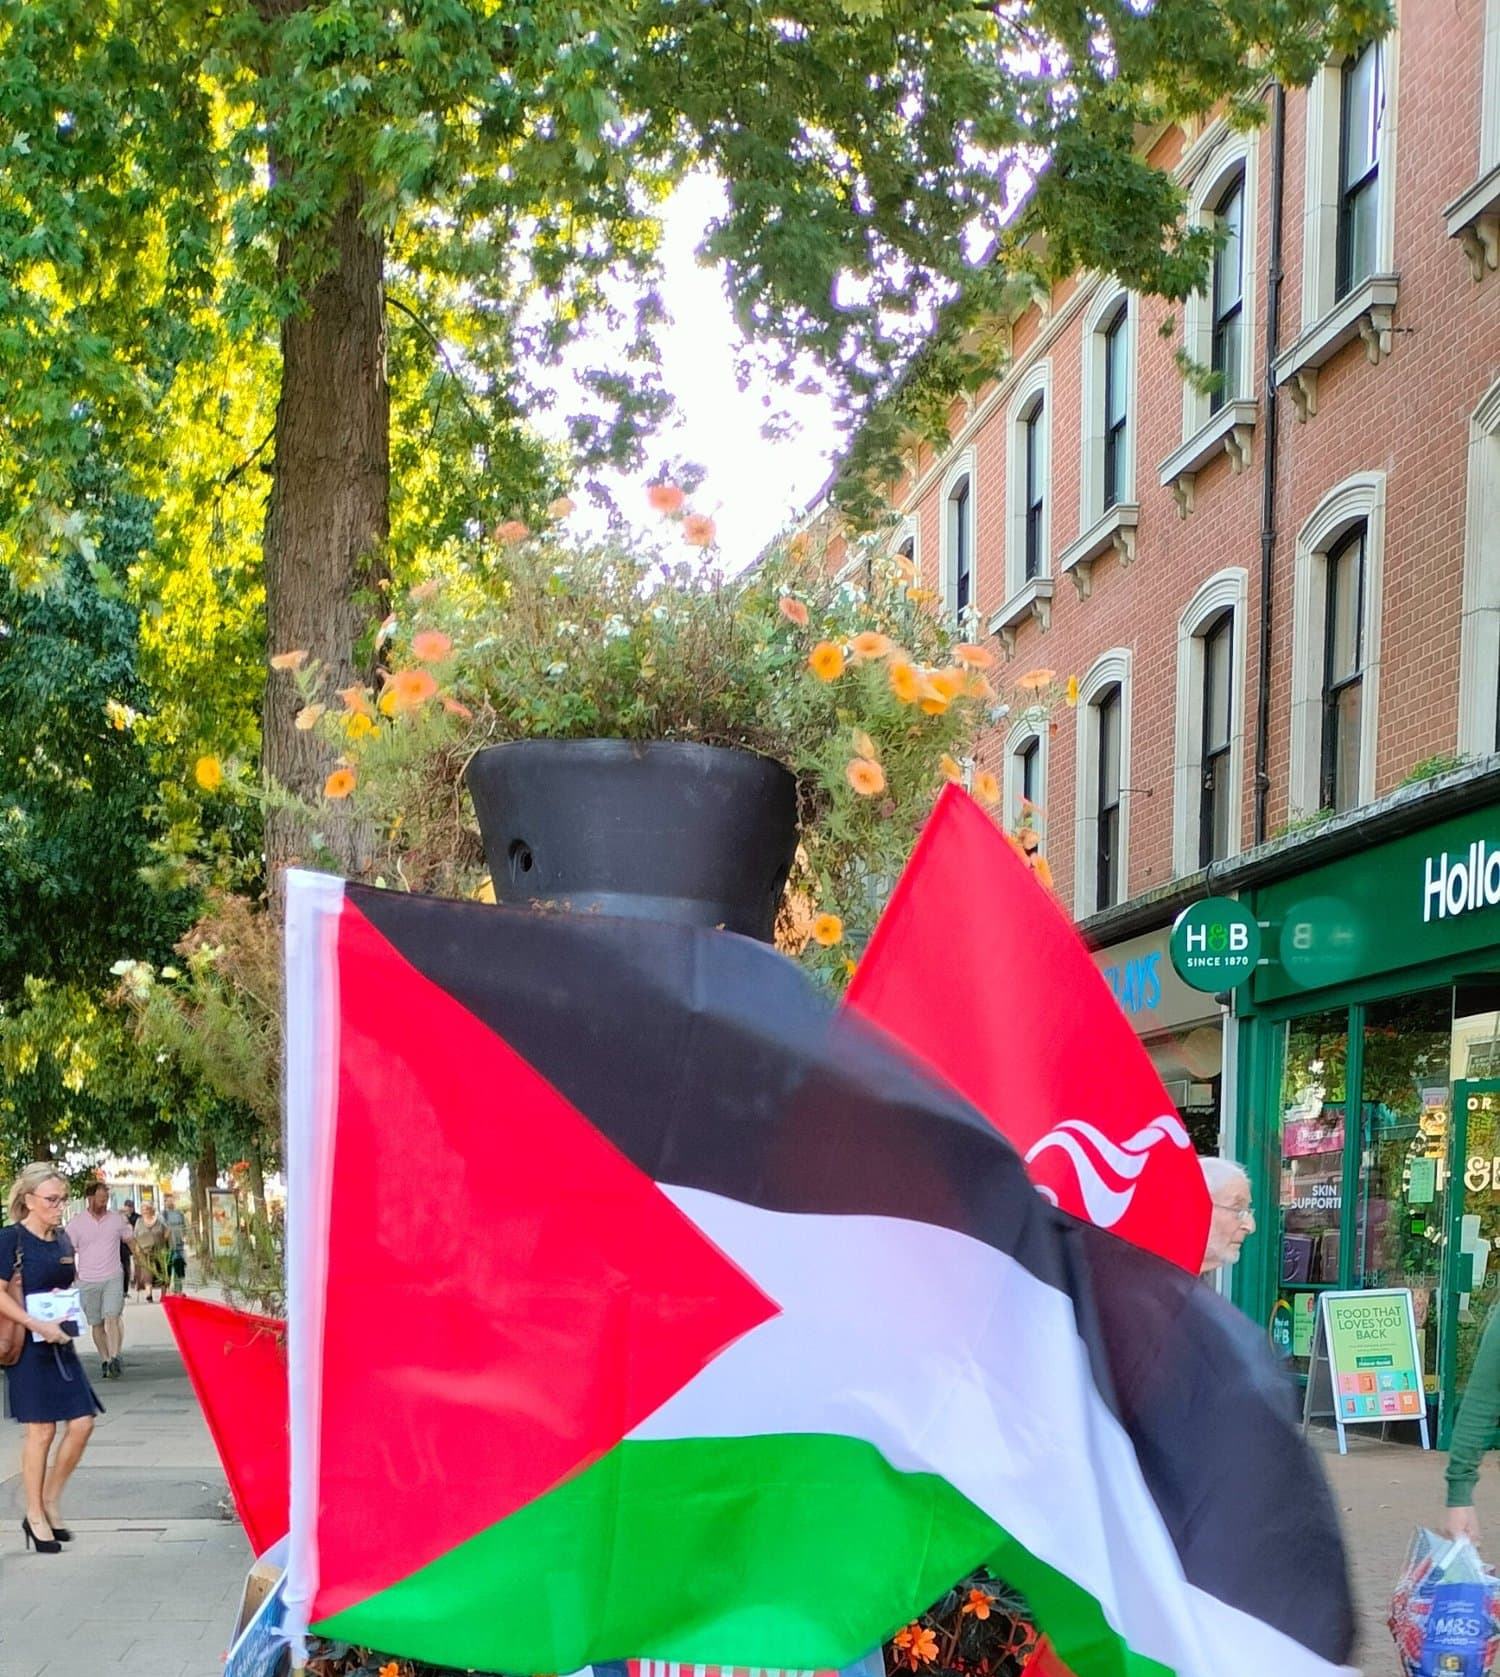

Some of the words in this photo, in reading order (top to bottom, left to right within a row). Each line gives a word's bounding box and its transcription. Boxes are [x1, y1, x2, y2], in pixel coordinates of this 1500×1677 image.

[1186, 923, 1248, 952] H&B
[1187, 957, 1221, 967] SINCE
[1224, 956, 1248, 966] 1870
[1312, 1185, 1337, 1197] SKIN
[1336, 1308, 1371, 1320] FOOD
[1373, 1305, 1401, 1318] THAT
[1339, 1318, 1375, 1330] LOVES
[1377, 1317, 1401, 1328] YOU
[1356, 1328, 1388, 1340] BACK
[1435, 1618, 1481, 1636] M&S
